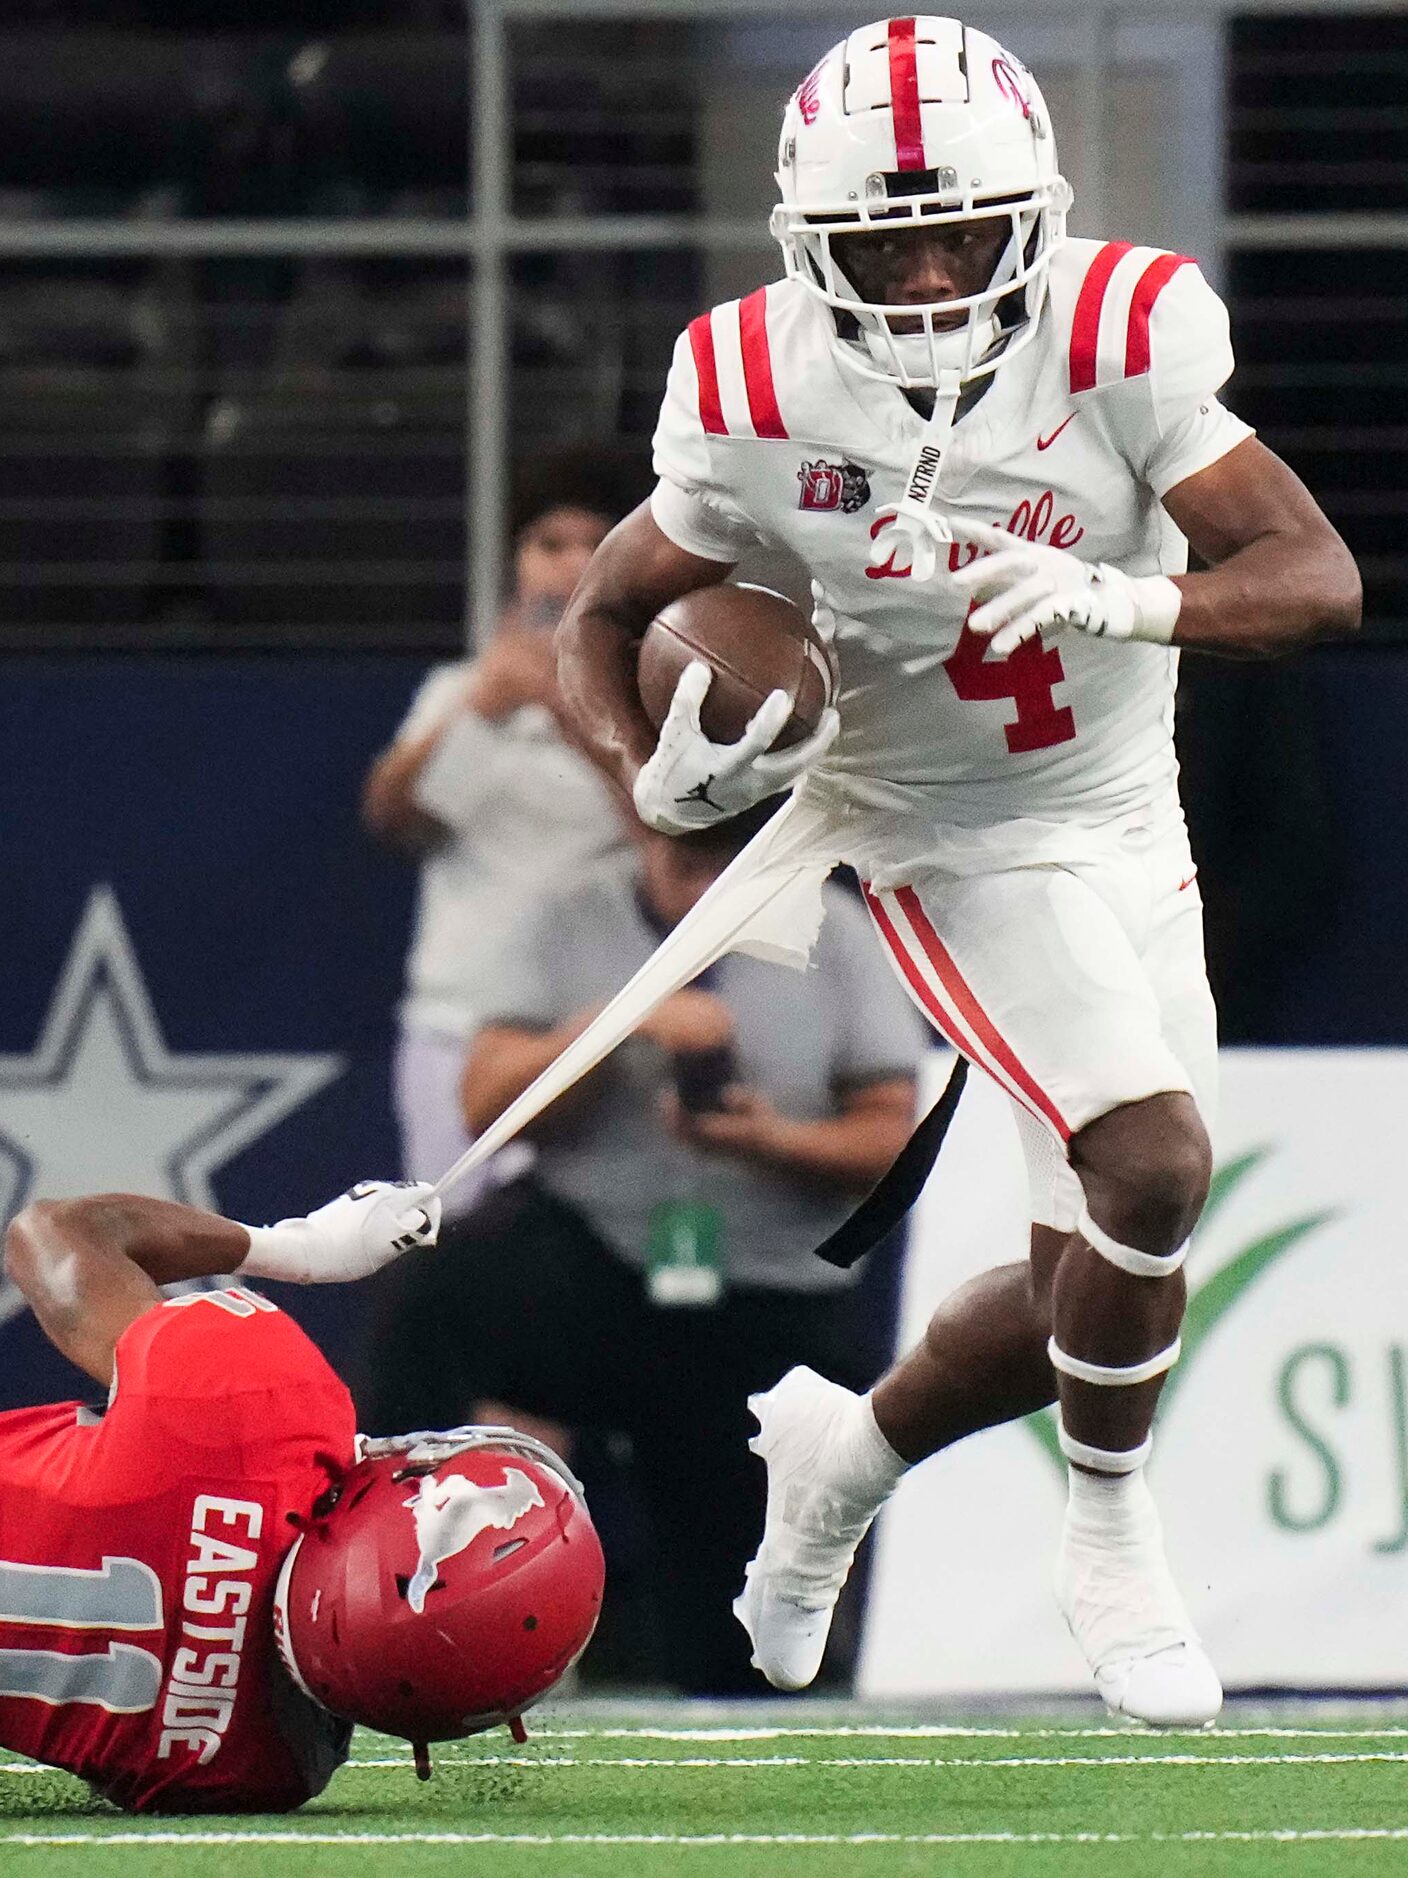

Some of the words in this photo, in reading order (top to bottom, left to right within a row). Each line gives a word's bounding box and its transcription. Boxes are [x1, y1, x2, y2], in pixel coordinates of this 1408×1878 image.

[908, 446, 941, 502] NXTRND
[942, 597, 1077, 754] 4
[157, 1493, 264, 1766] EASTSIDE
